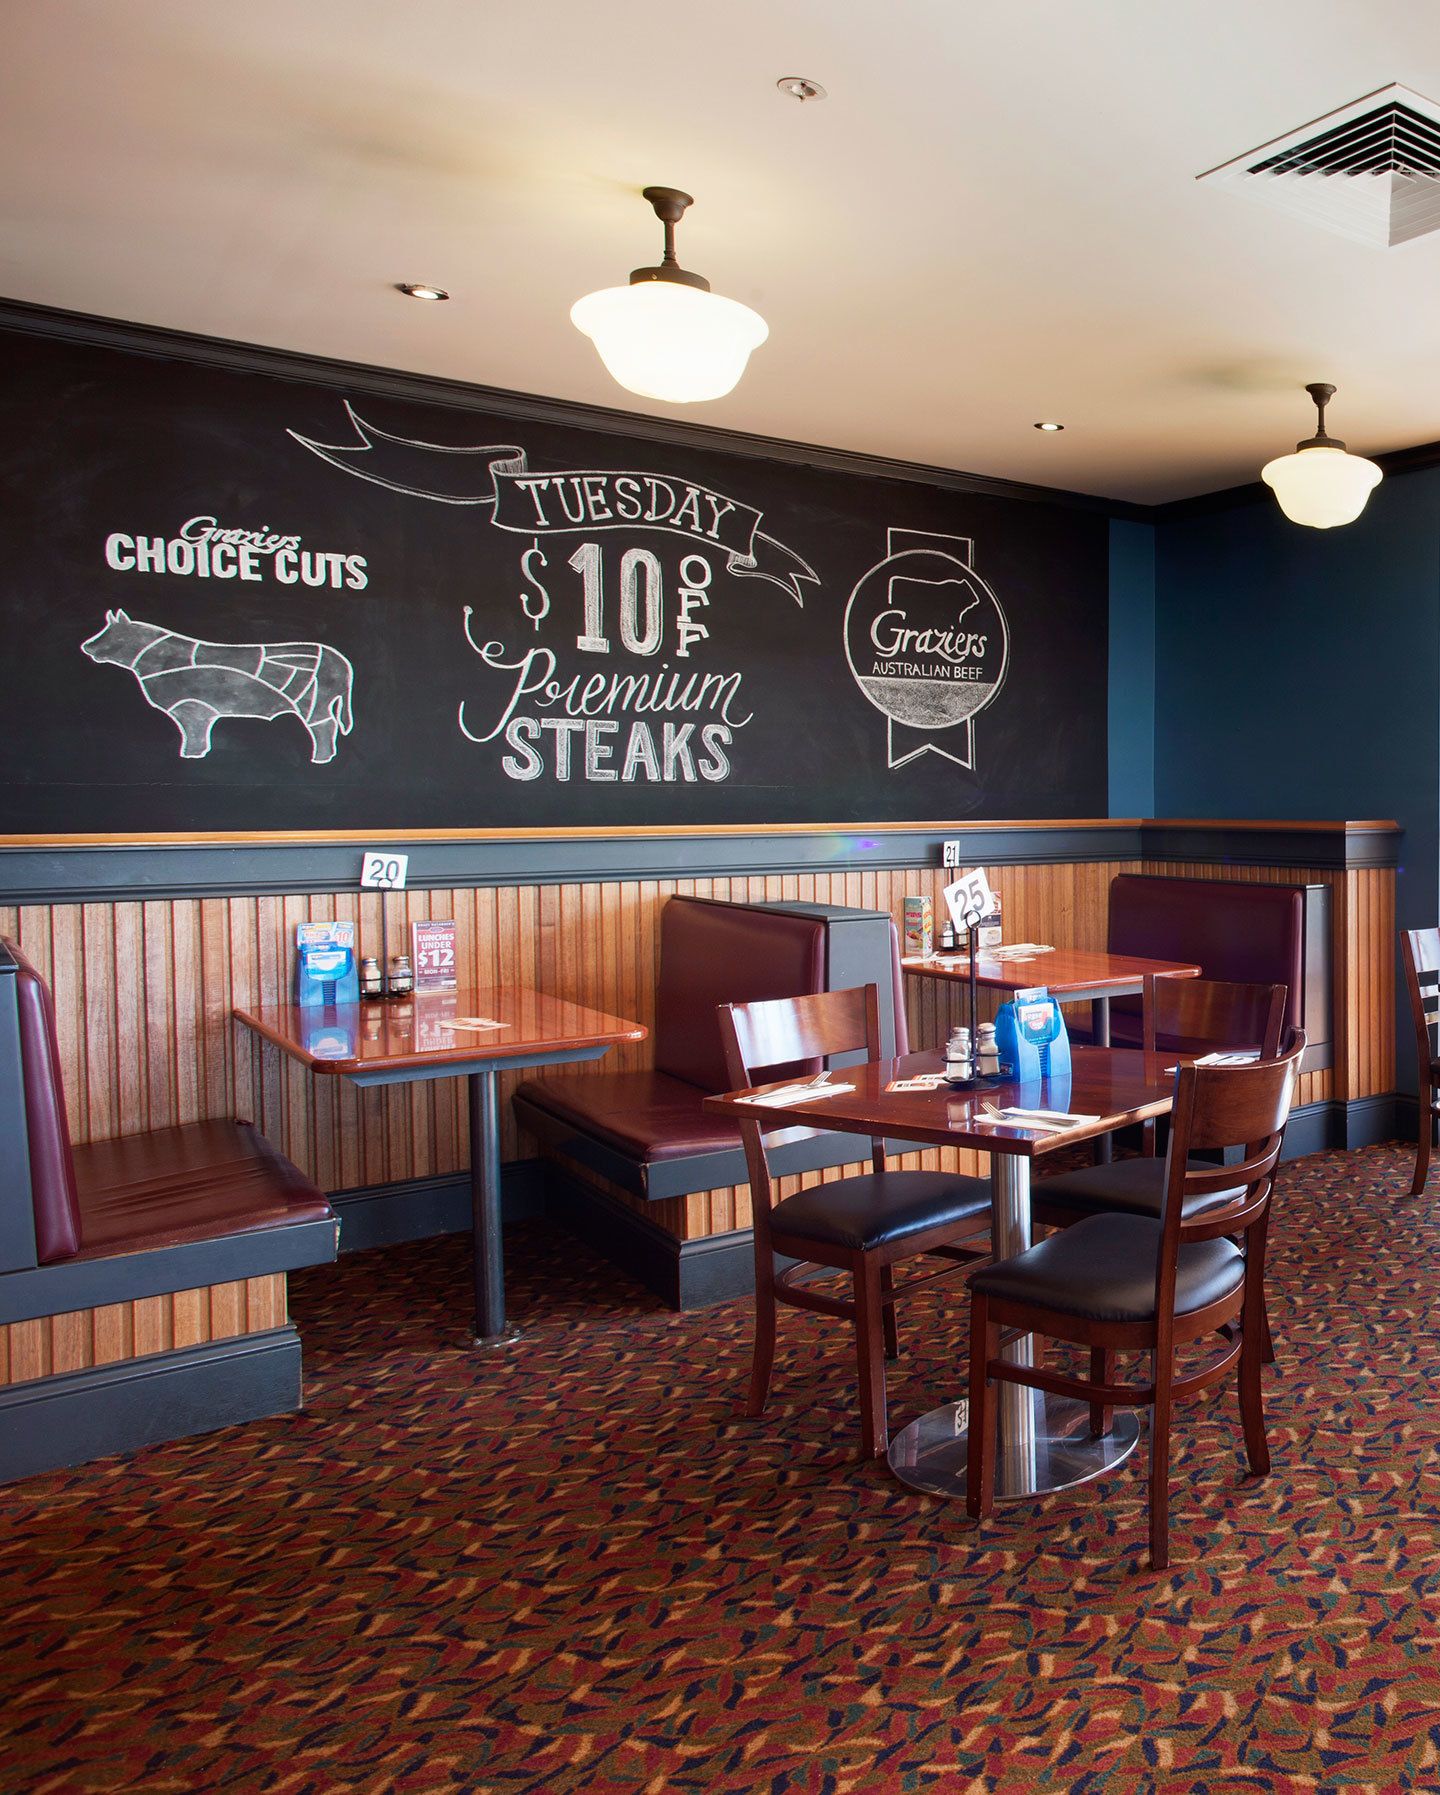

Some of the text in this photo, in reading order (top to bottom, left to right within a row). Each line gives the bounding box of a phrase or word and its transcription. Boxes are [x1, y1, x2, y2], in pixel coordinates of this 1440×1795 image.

[514, 477, 736, 539] TUESDAY
[180, 516, 301, 554] Graziers
[105, 533, 369, 590] CHOICE CUTS
[676, 554, 712, 657] OFF
[870, 609, 988, 664] Graziers
[459, 606, 753, 742] Premium
[872, 660, 983, 680] AUSTRALIAN BEEF
[502, 716, 733, 783] STEAKS
[369, 859, 400, 881] 20
[946, 846, 956, 862] 21
[954, 879, 985, 921] 25
[418, 933, 455, 942] LUNCHES
[421, 941, 452, 949] UNDER
[418, 949, 454, 967] $12
